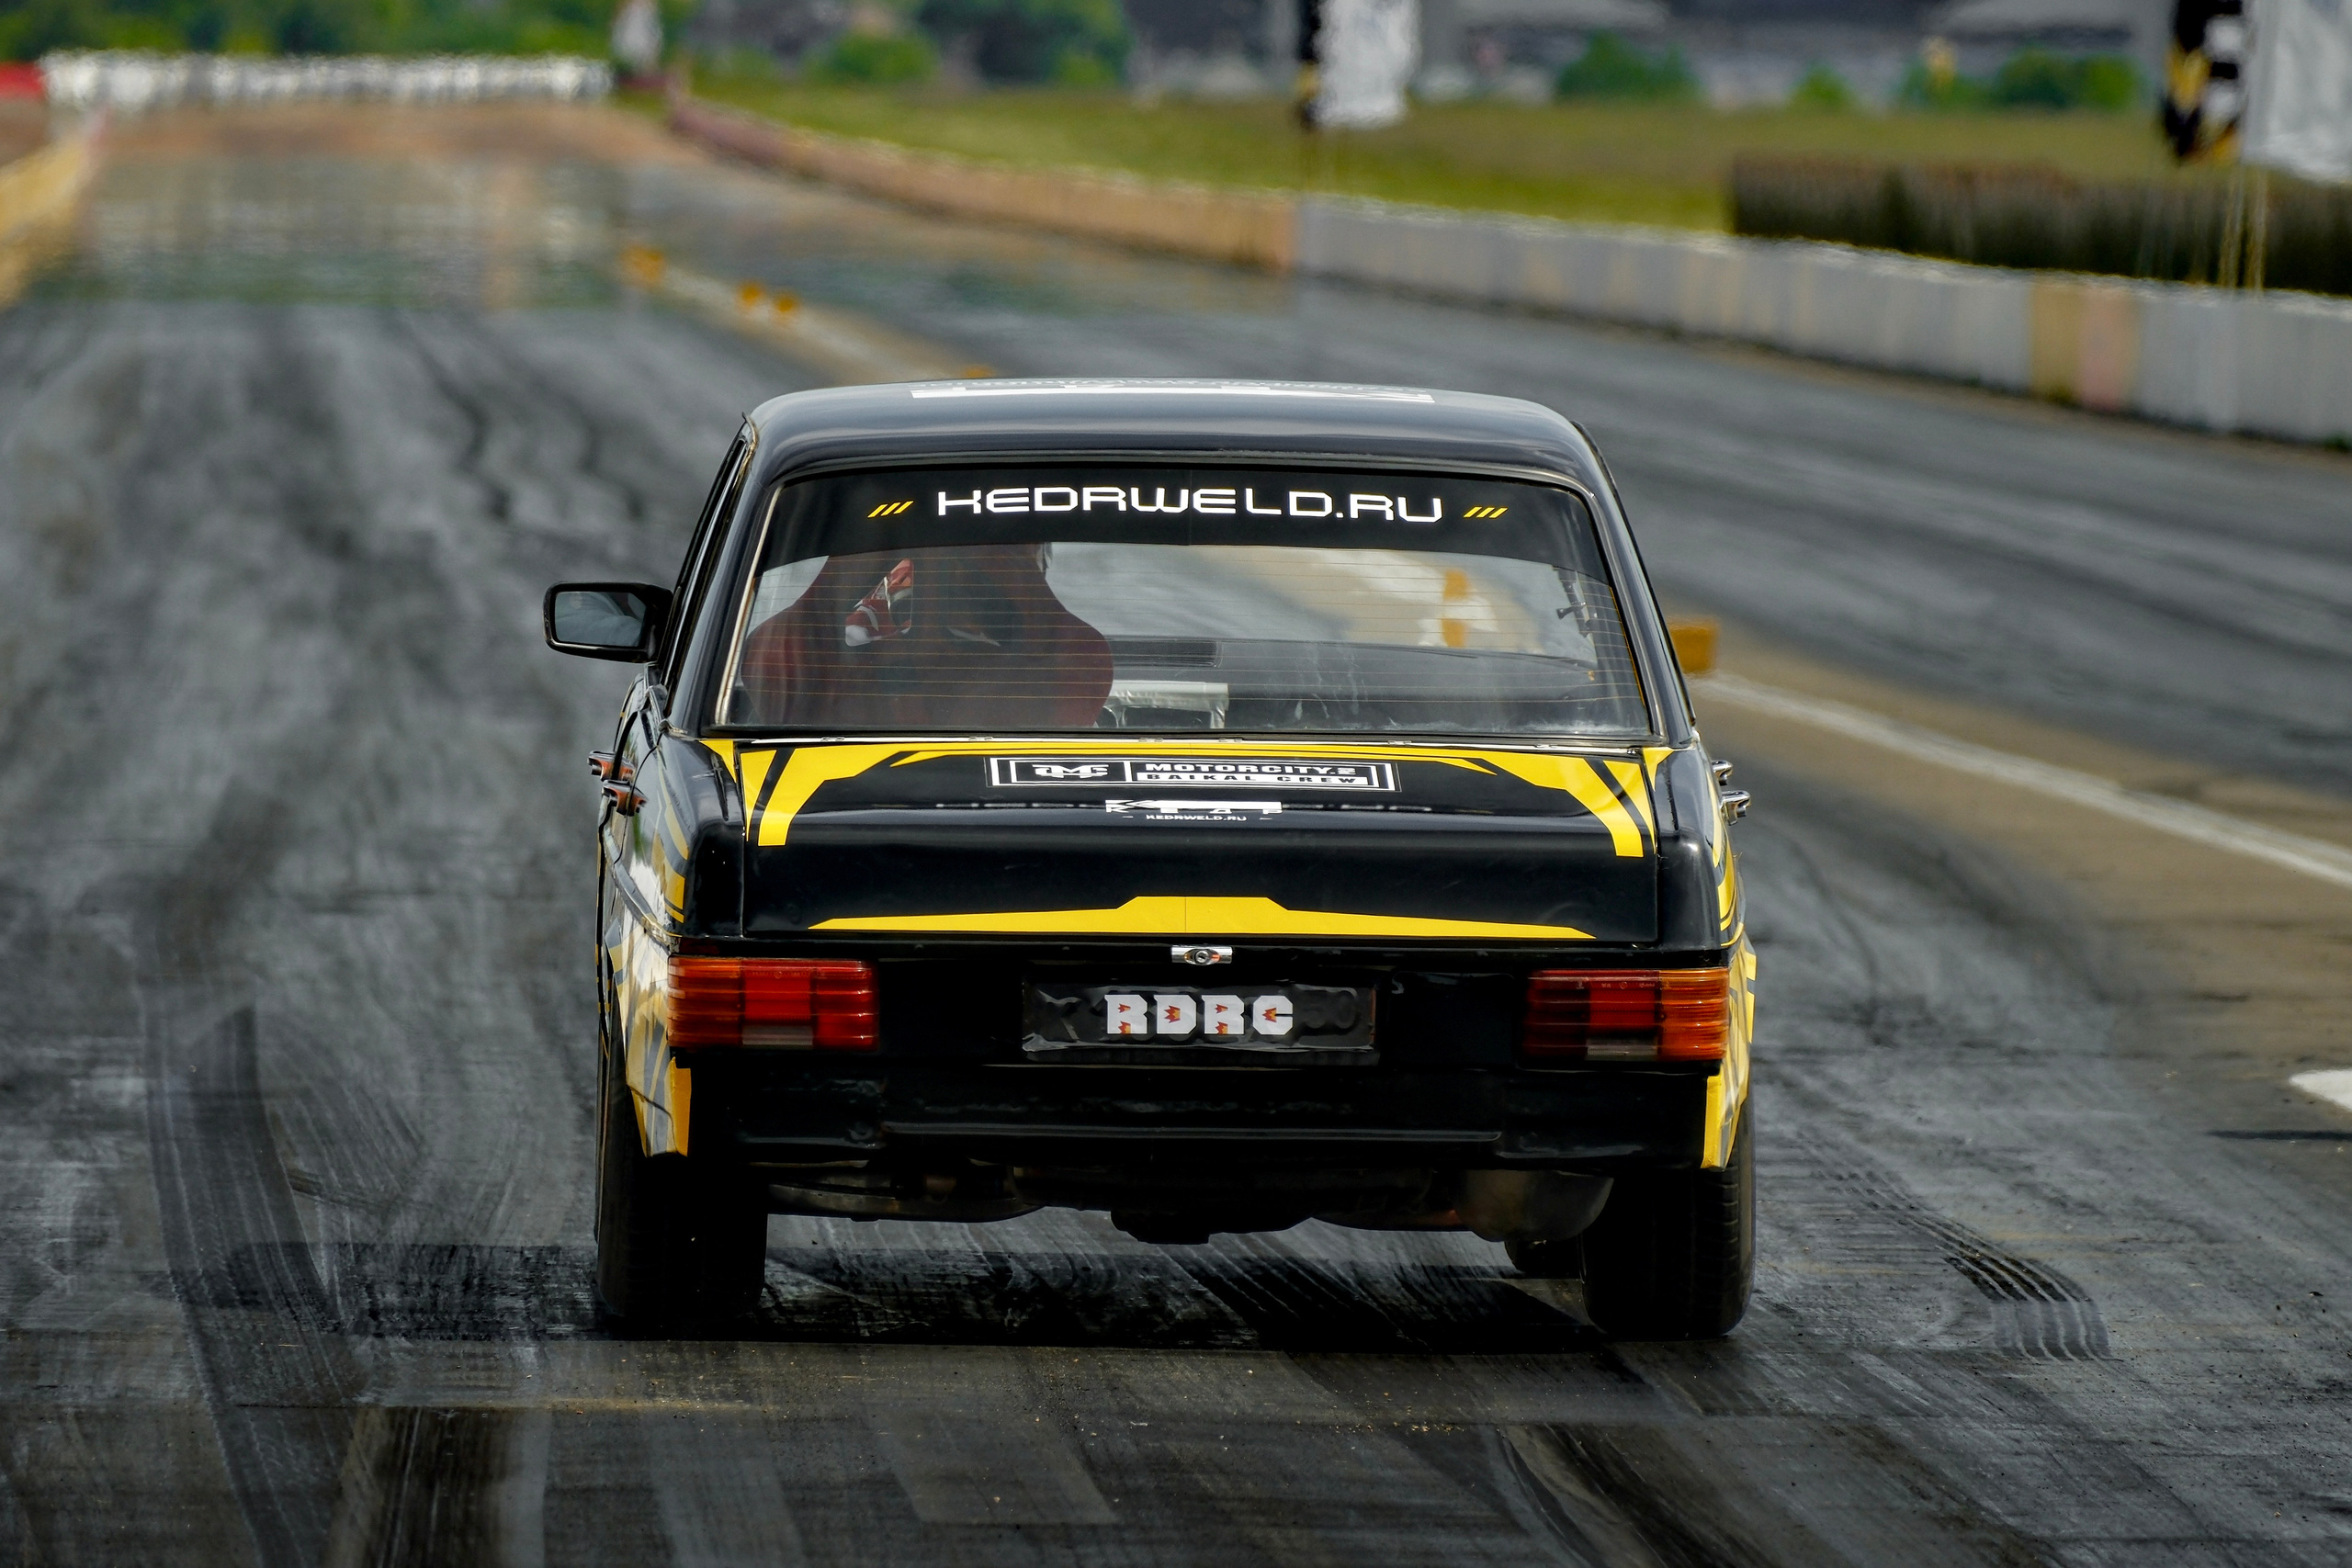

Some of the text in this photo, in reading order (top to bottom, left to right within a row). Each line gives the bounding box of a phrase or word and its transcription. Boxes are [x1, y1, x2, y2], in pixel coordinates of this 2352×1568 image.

[937, 487, 1443, 524] KEDRWELD.RU
[1146, 773, 1257, 782] BAIKAL
[1104, 994, 1294, 1034] RDRC
